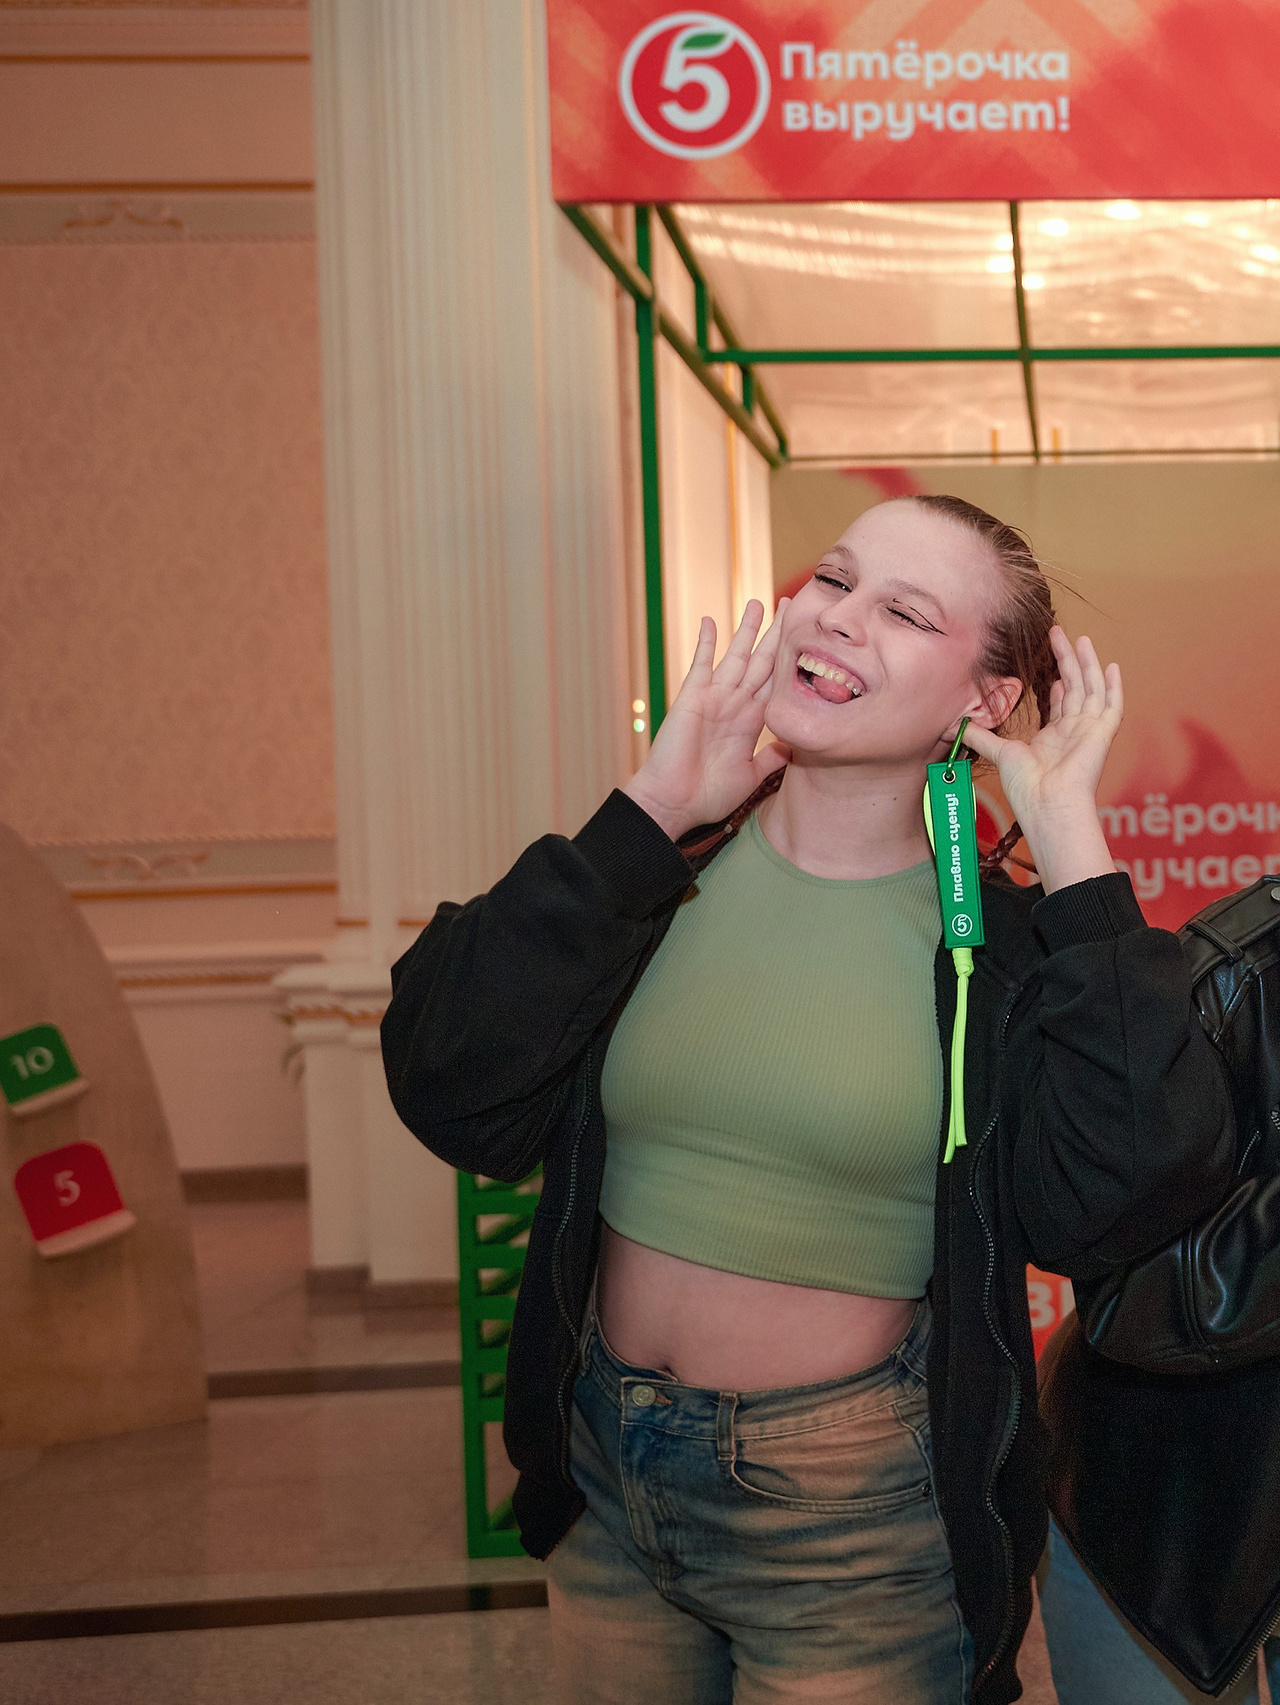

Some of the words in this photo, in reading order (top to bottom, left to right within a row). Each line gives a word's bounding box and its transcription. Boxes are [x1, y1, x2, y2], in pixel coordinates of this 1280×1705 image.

[659, 26, 735, 132] 5
[781, 41, 1070, 88] Пятёрочка
[782, 96, 1070, 140] выручает!
[945, 793, 961, 842] сцену!
[950, 844, 964, 903] Плавлю
[10, 1046, 55, 1081] 10
[54, 1169, 81, 1207] 5
